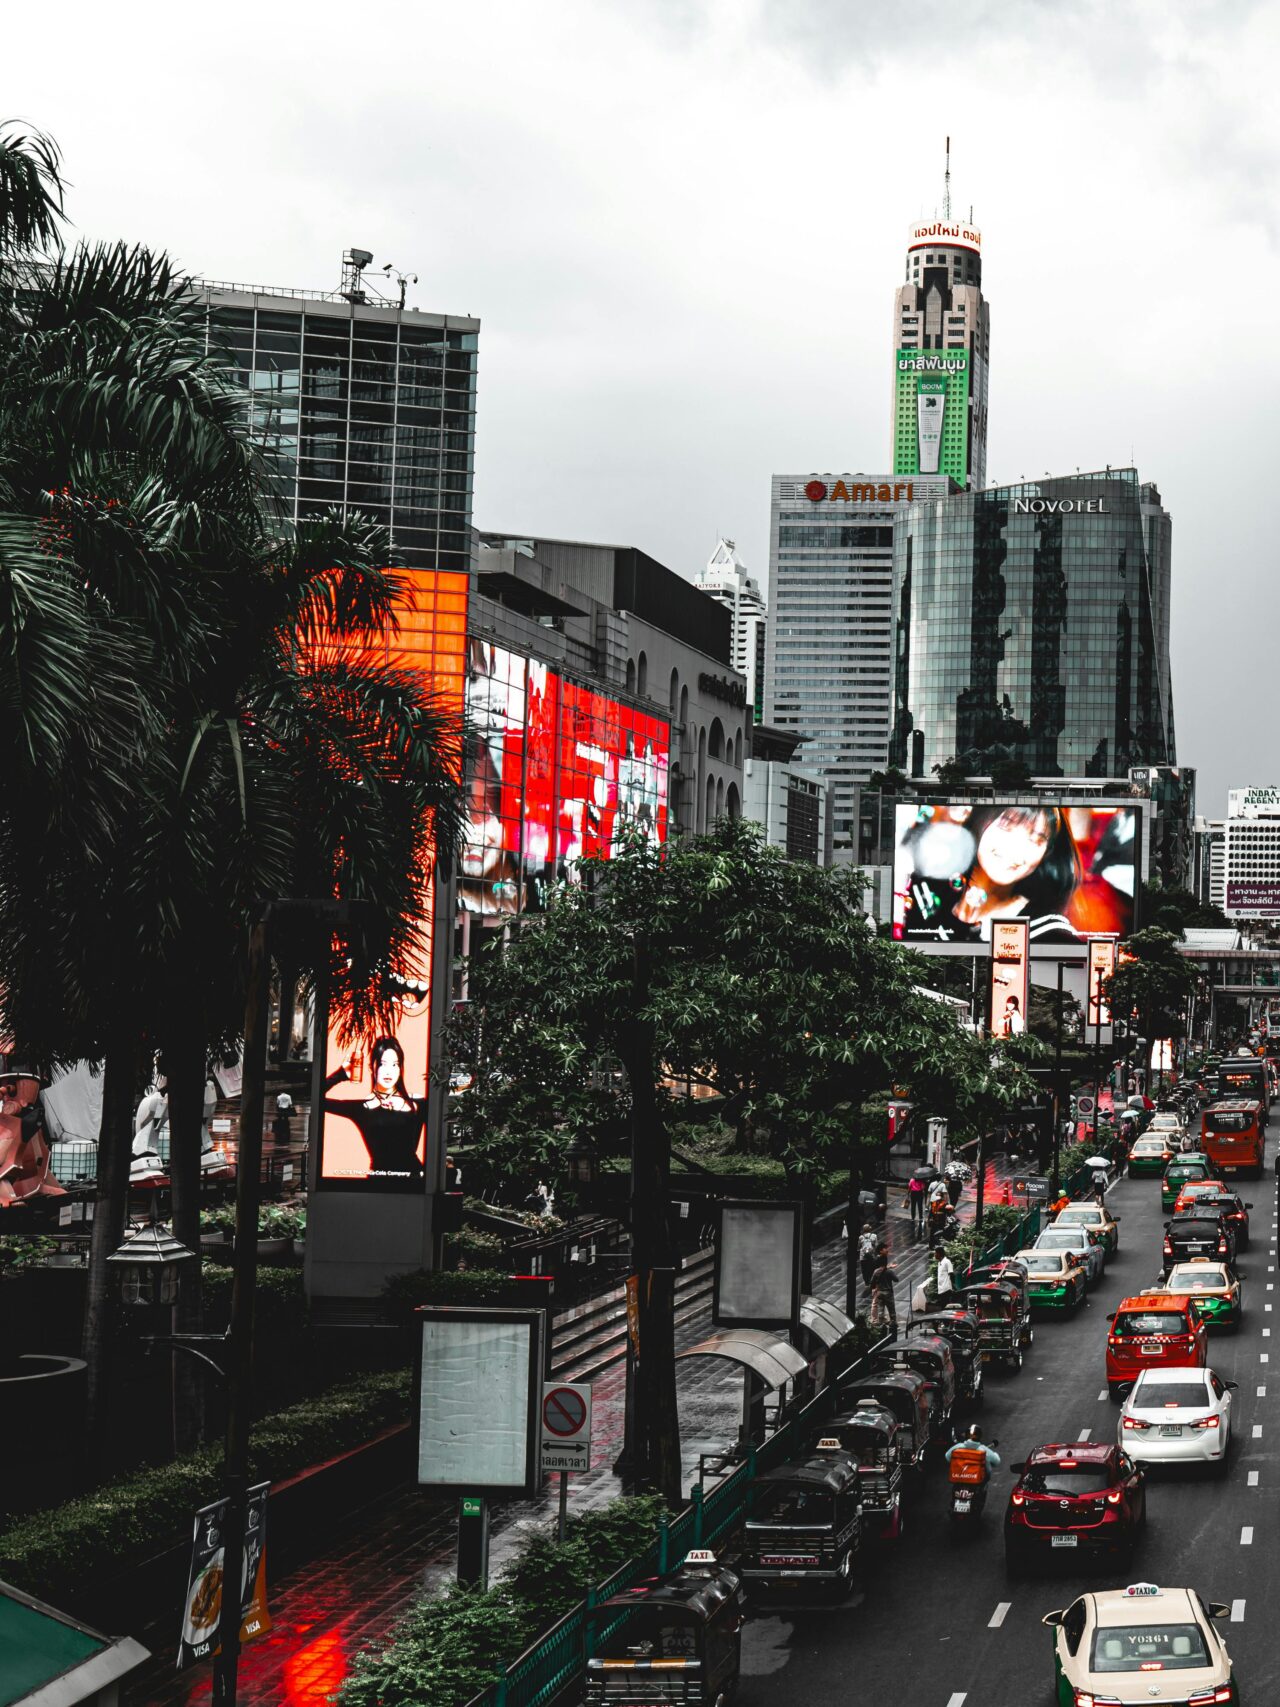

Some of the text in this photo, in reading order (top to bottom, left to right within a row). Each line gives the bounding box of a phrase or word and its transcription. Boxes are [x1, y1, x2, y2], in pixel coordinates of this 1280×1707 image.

[914, 223, 959, 238] แอปใหม่
[831, 480, 914, 502] Amari
[1014, 498, 1110, 514] NOVOTEL
[690, 1551, 709, 1560] TAXI
[1135, 1587, 1151, 1595] TAXI
[245, 1620, 261, 1635] VISA
[1128, 1634, 1169, 1644] Y0361
[193, 1643, 210, 1657] VISA
